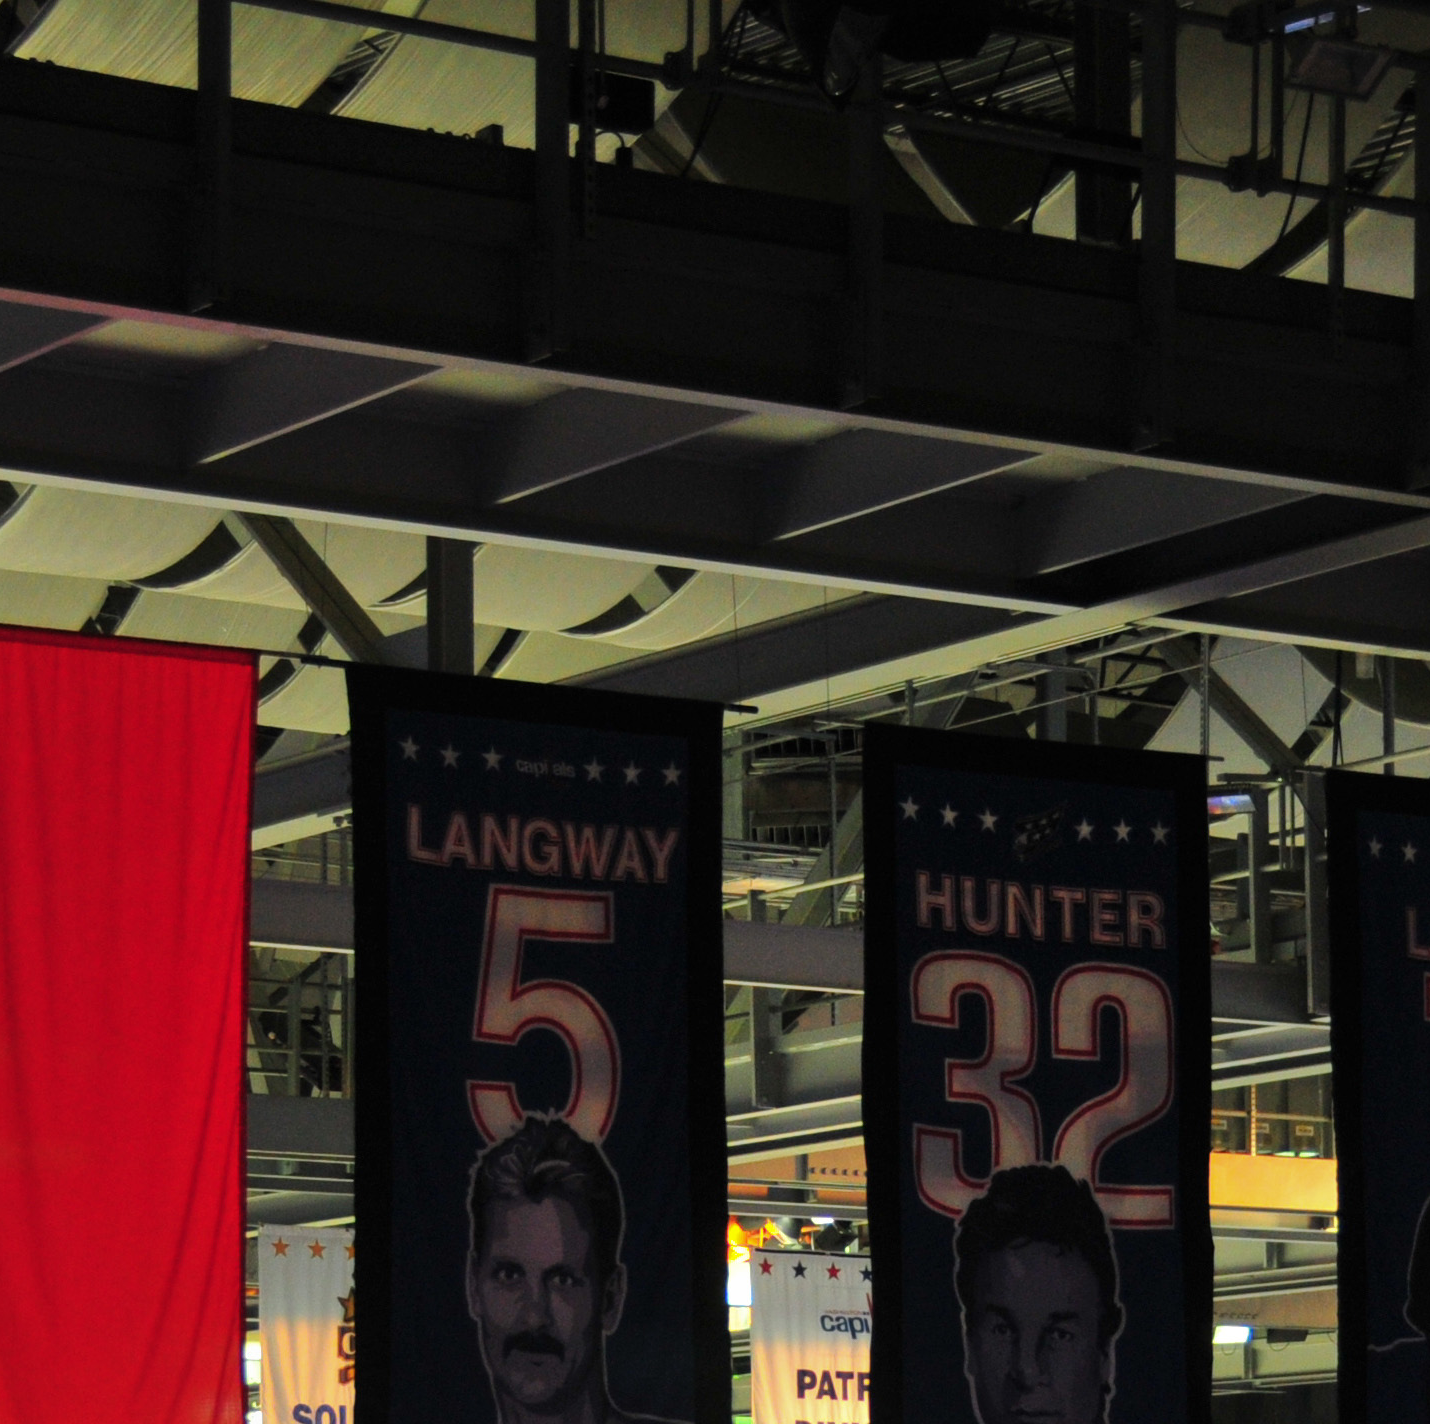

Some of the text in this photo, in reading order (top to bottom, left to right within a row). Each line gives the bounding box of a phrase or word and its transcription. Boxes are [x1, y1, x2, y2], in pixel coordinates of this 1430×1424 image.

[407, 803, 679, 884] LANGWAY
[916, 869, 1167, 949] HUNTER
[465, 883, 622, 1150] 5
[910, 949, 1175, 1230] 32
